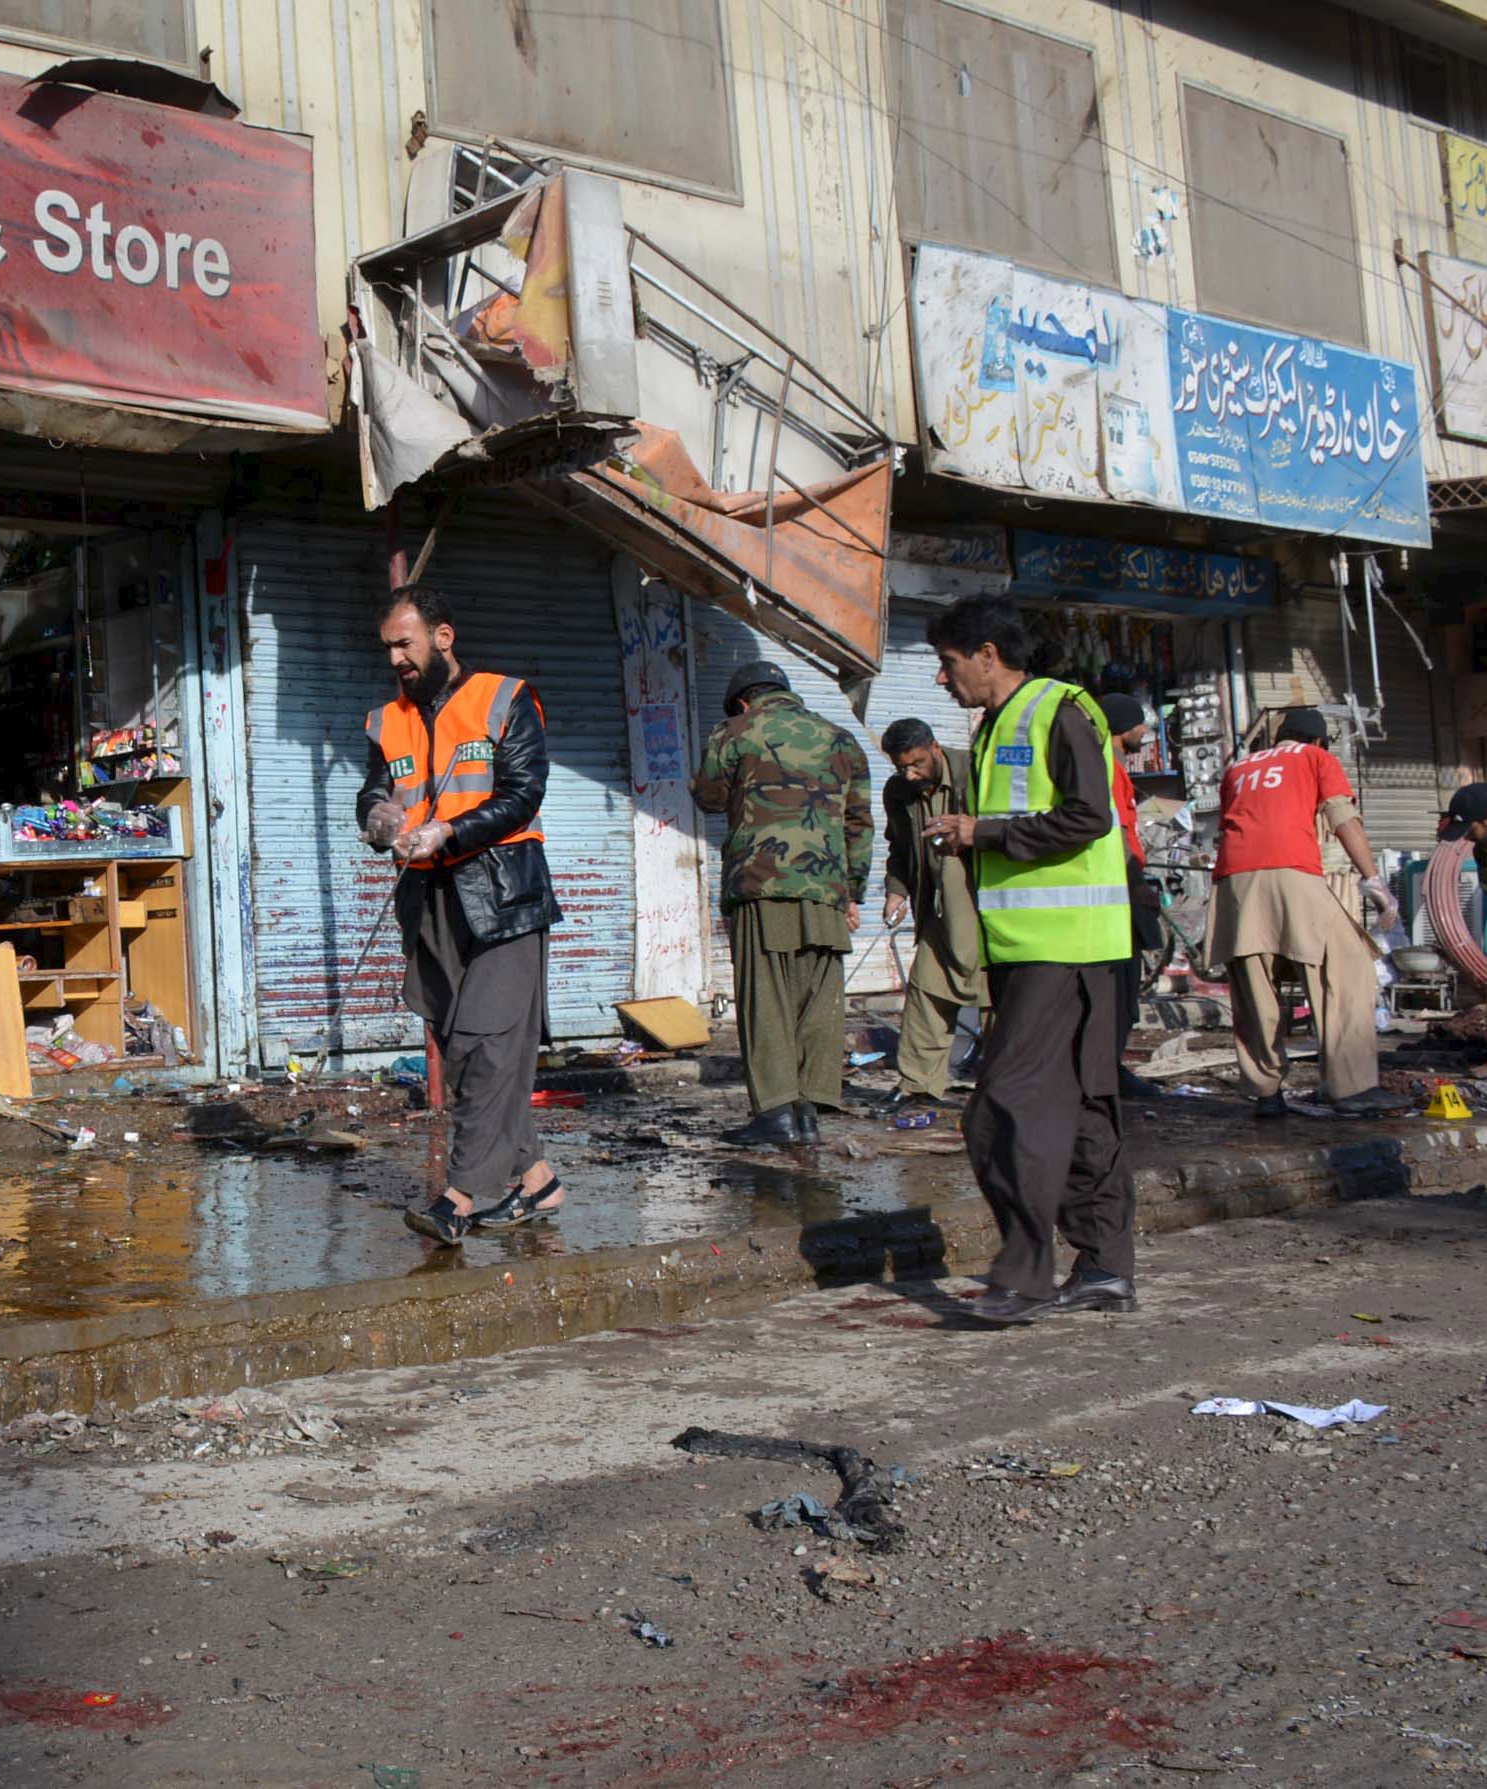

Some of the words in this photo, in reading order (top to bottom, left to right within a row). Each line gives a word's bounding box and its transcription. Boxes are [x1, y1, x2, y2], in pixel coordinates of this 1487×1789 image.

[32, 190, 231, 297] Store
[1354, 382, 1407, 464] خان
[998, 748, 1031, 763] POLICE
[1234, 765, 1284, 795] 115
[1444, 1091, 1461, 1108] 14
